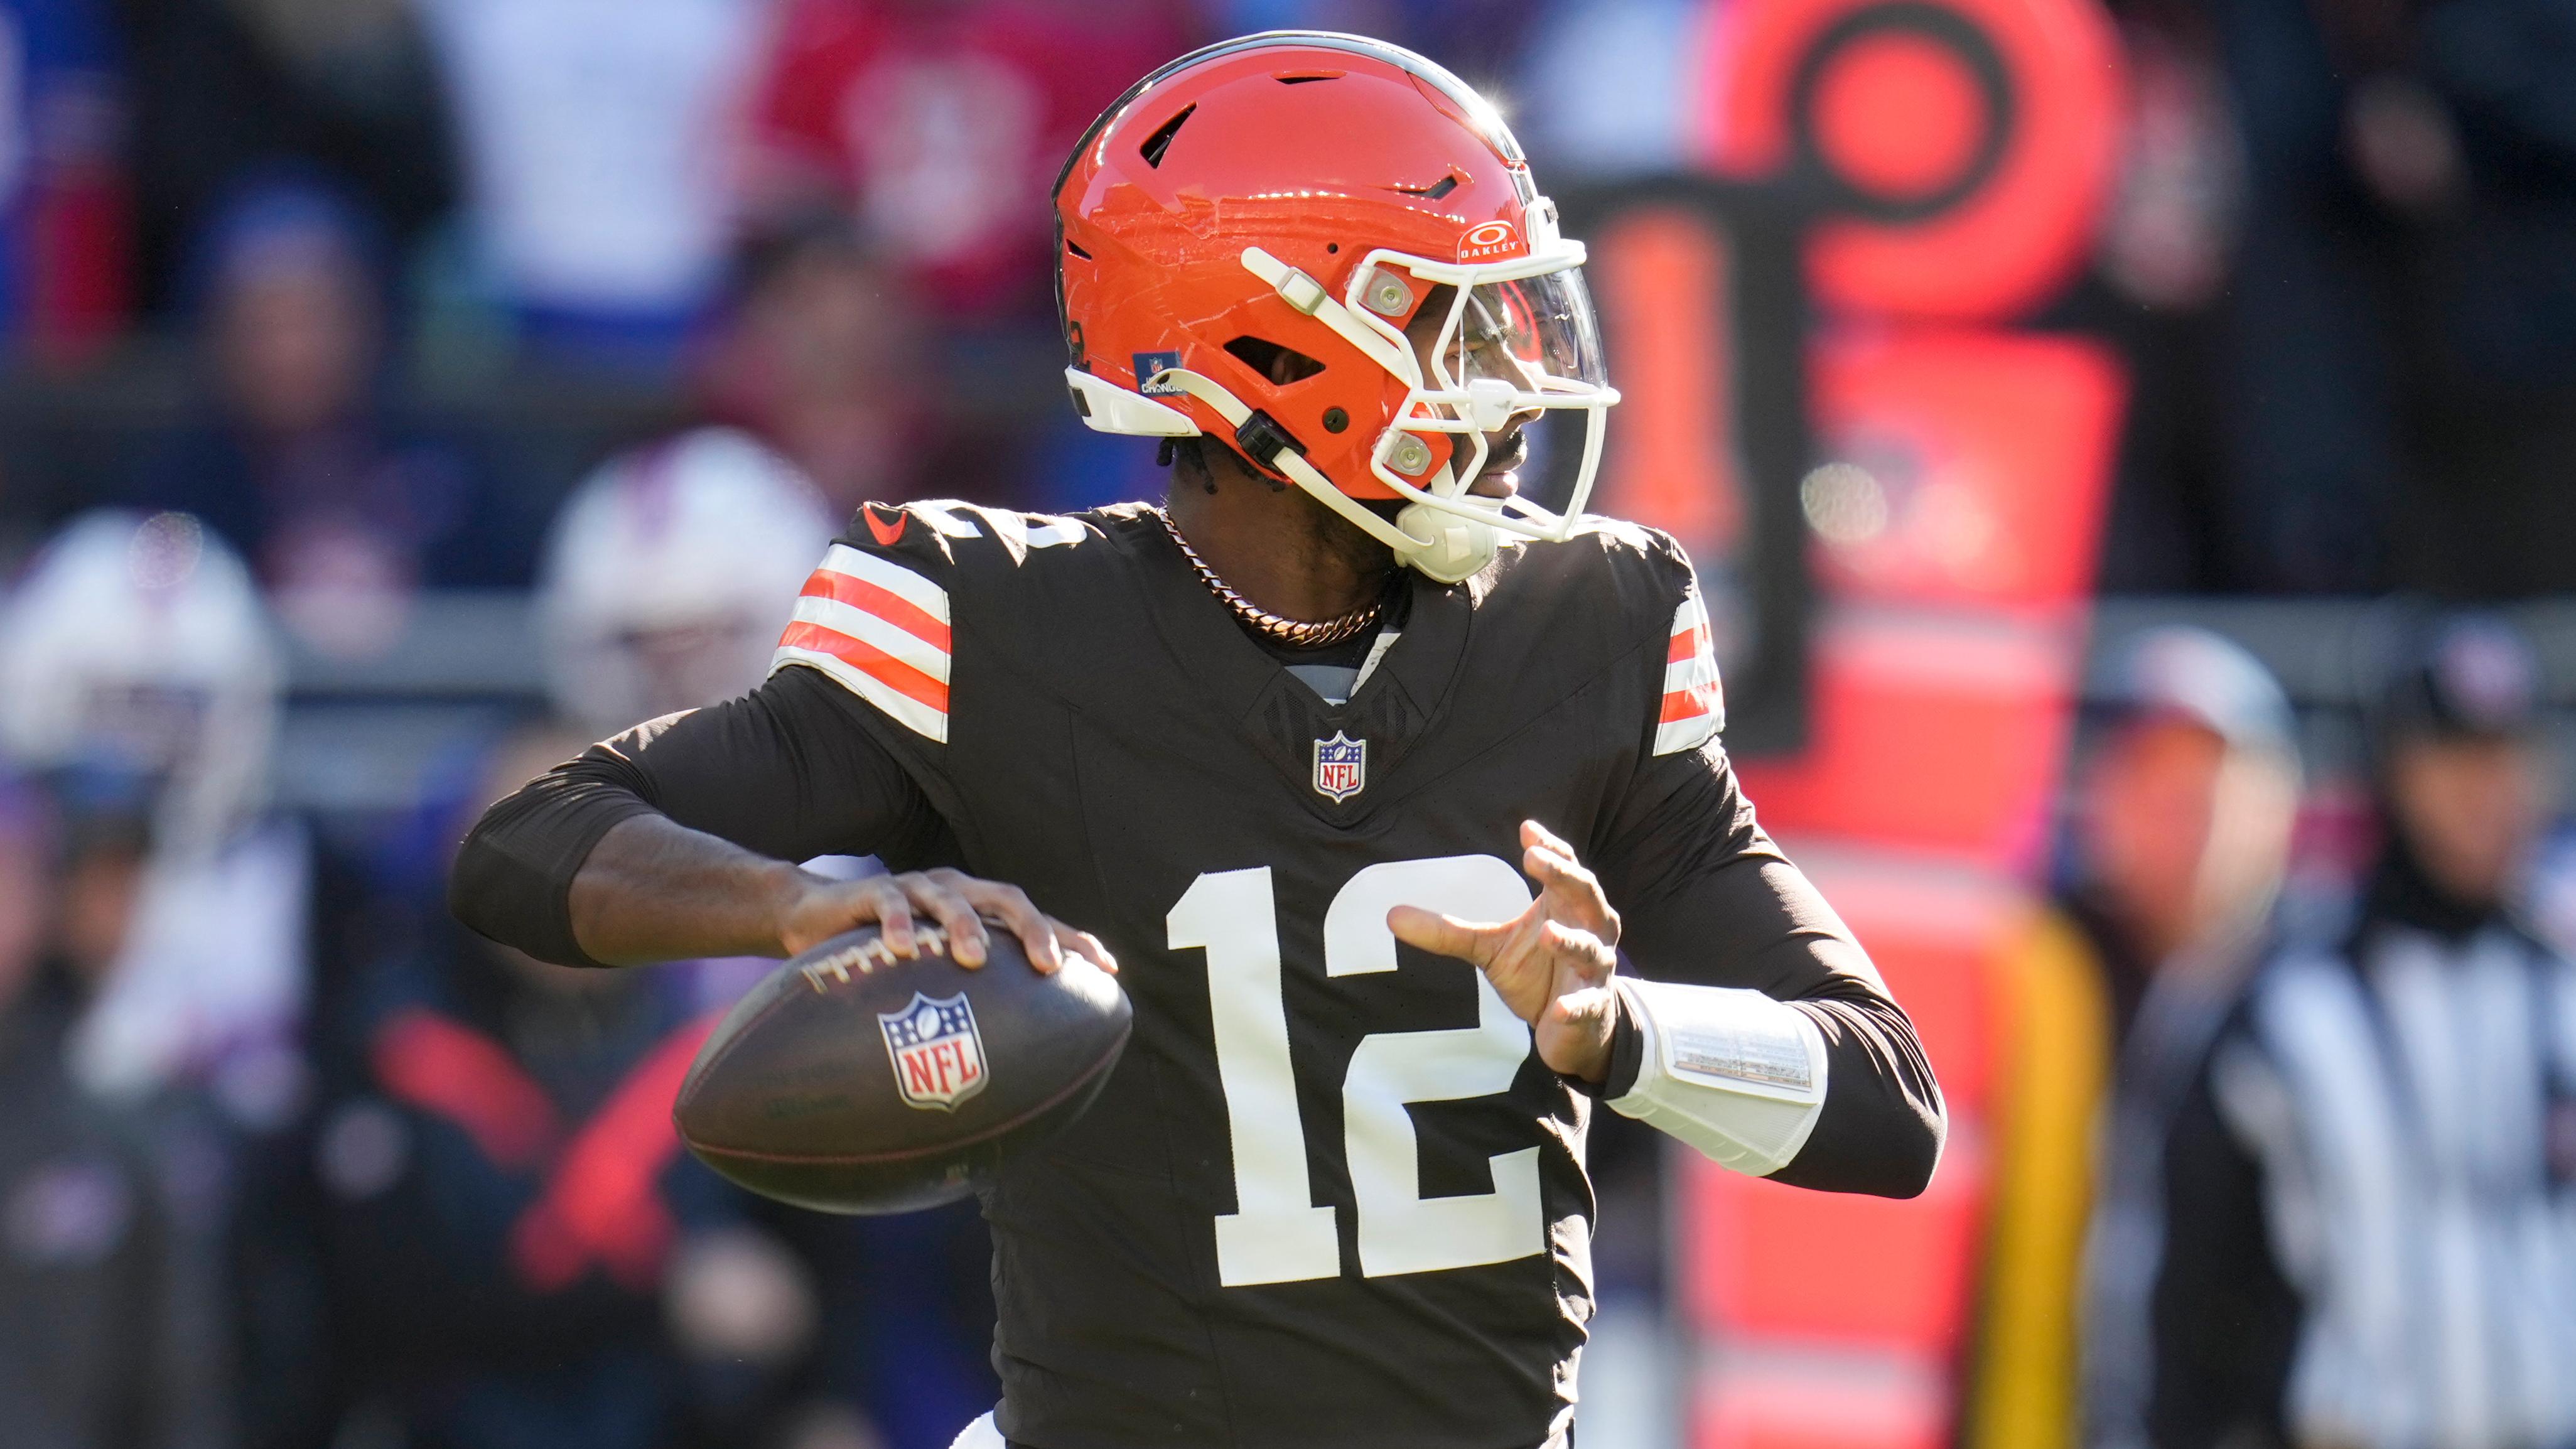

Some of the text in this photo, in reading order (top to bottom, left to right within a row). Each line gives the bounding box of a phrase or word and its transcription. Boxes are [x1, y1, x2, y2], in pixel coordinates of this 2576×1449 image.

[1461, 241, 1517, 259] OAKLEY
[1322, 764, 1357, 790] NFL
[902, 1038, 979, 1096] NFL
[1166, 853, 1545, 1287] 12
